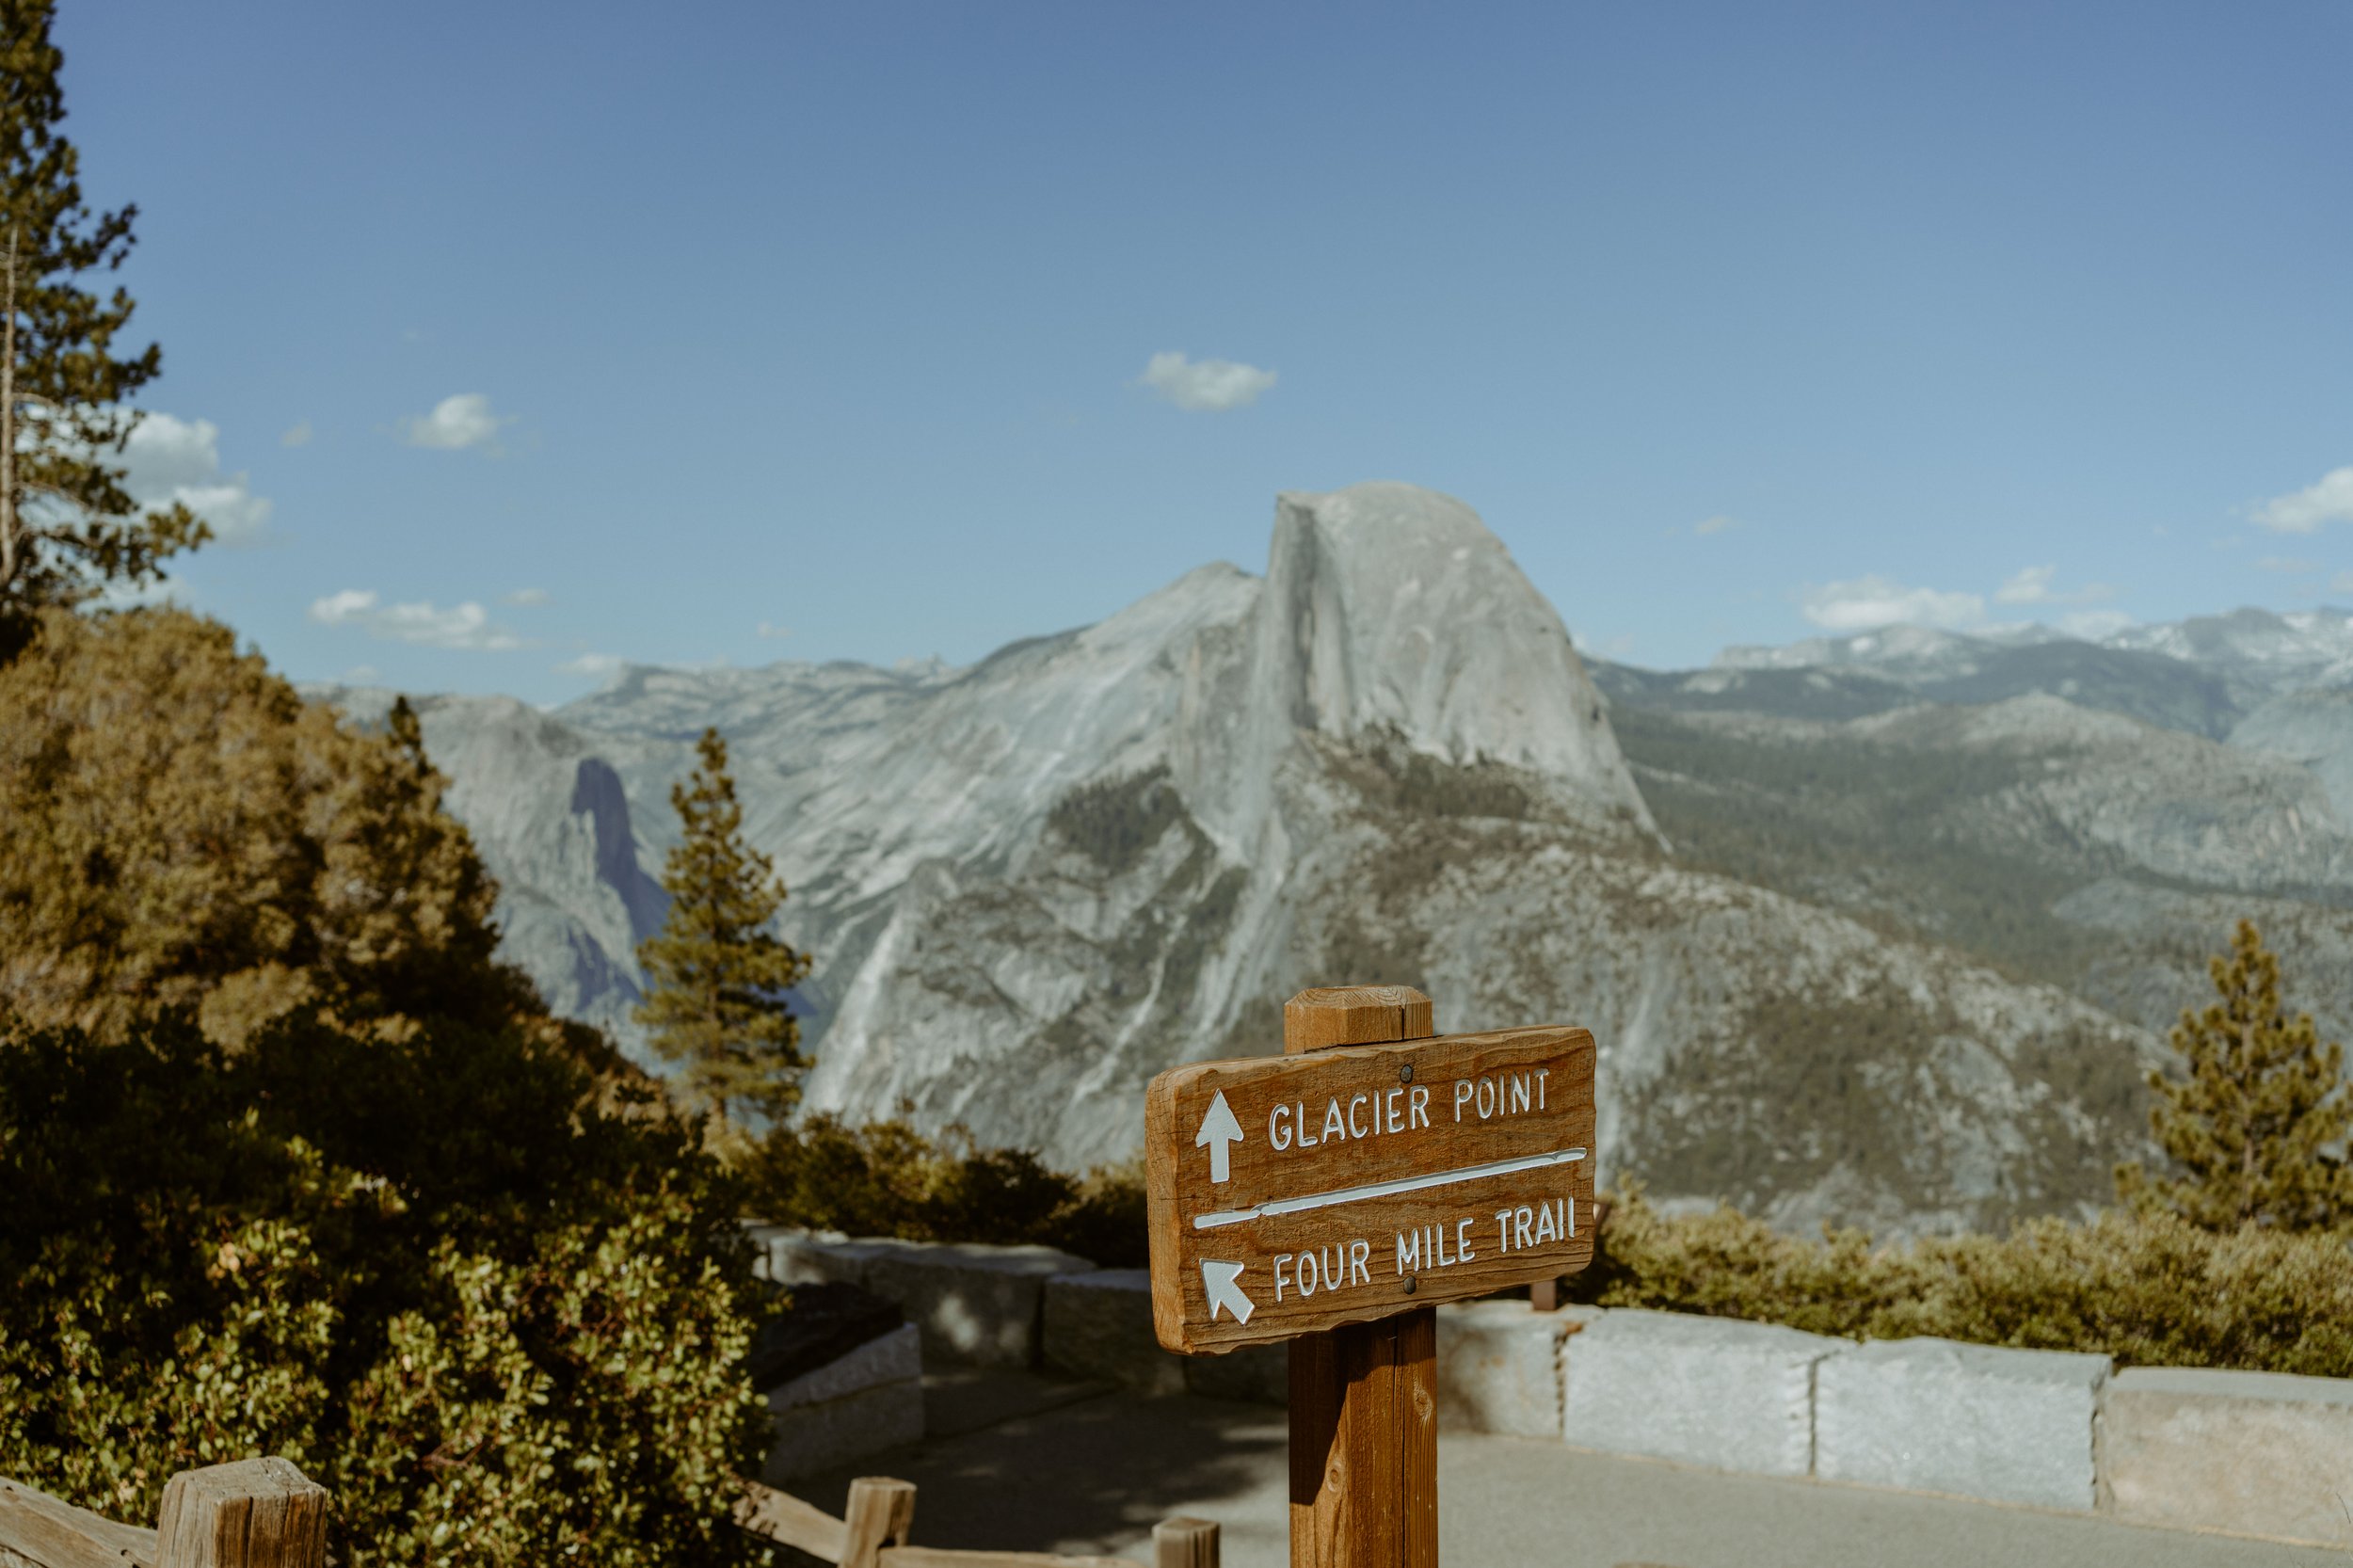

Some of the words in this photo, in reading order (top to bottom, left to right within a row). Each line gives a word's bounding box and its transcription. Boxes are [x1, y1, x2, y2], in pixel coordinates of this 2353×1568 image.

[1268, 1084, 1430, 1151] GLACIER
[1453, 1067, 1550, 1123] POINT
[1273, 1239, 1371, 1302] FOUR
[1396, 1217, 1476, 1276] MILE
